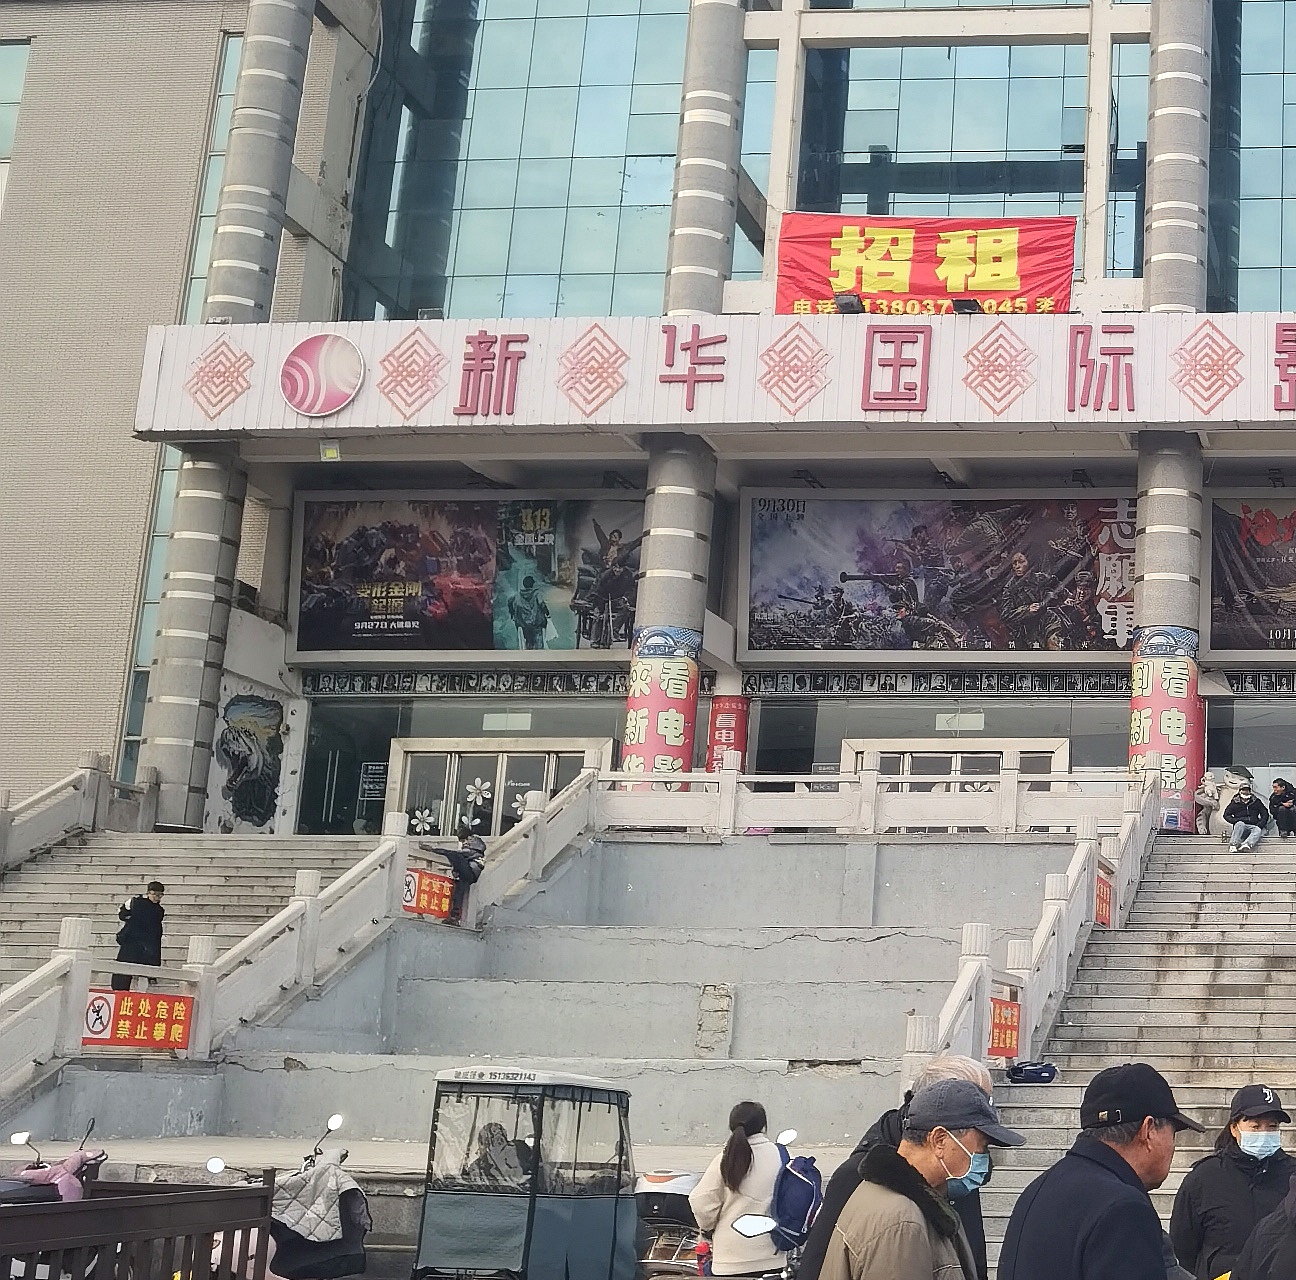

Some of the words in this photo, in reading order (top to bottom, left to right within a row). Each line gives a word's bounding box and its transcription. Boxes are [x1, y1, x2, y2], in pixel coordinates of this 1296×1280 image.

[828, 225, 1021, 293] 招租
[863, 298, 1028, 315] 138037045
[758, 498, 806, 513] 9月30日
[356, 581, 422, 598] 变形金刚
[652, 661, 690, 792] 看电影
[1160, 660, 1190, 791] 看电影
[420, 875, 453, 896] 此处危
[419, 893, 450, 912] 禁止攀
[119, 996, 186, 1020] 此处危险
[116, 1019, 184, 1043] 禁止攀爬
